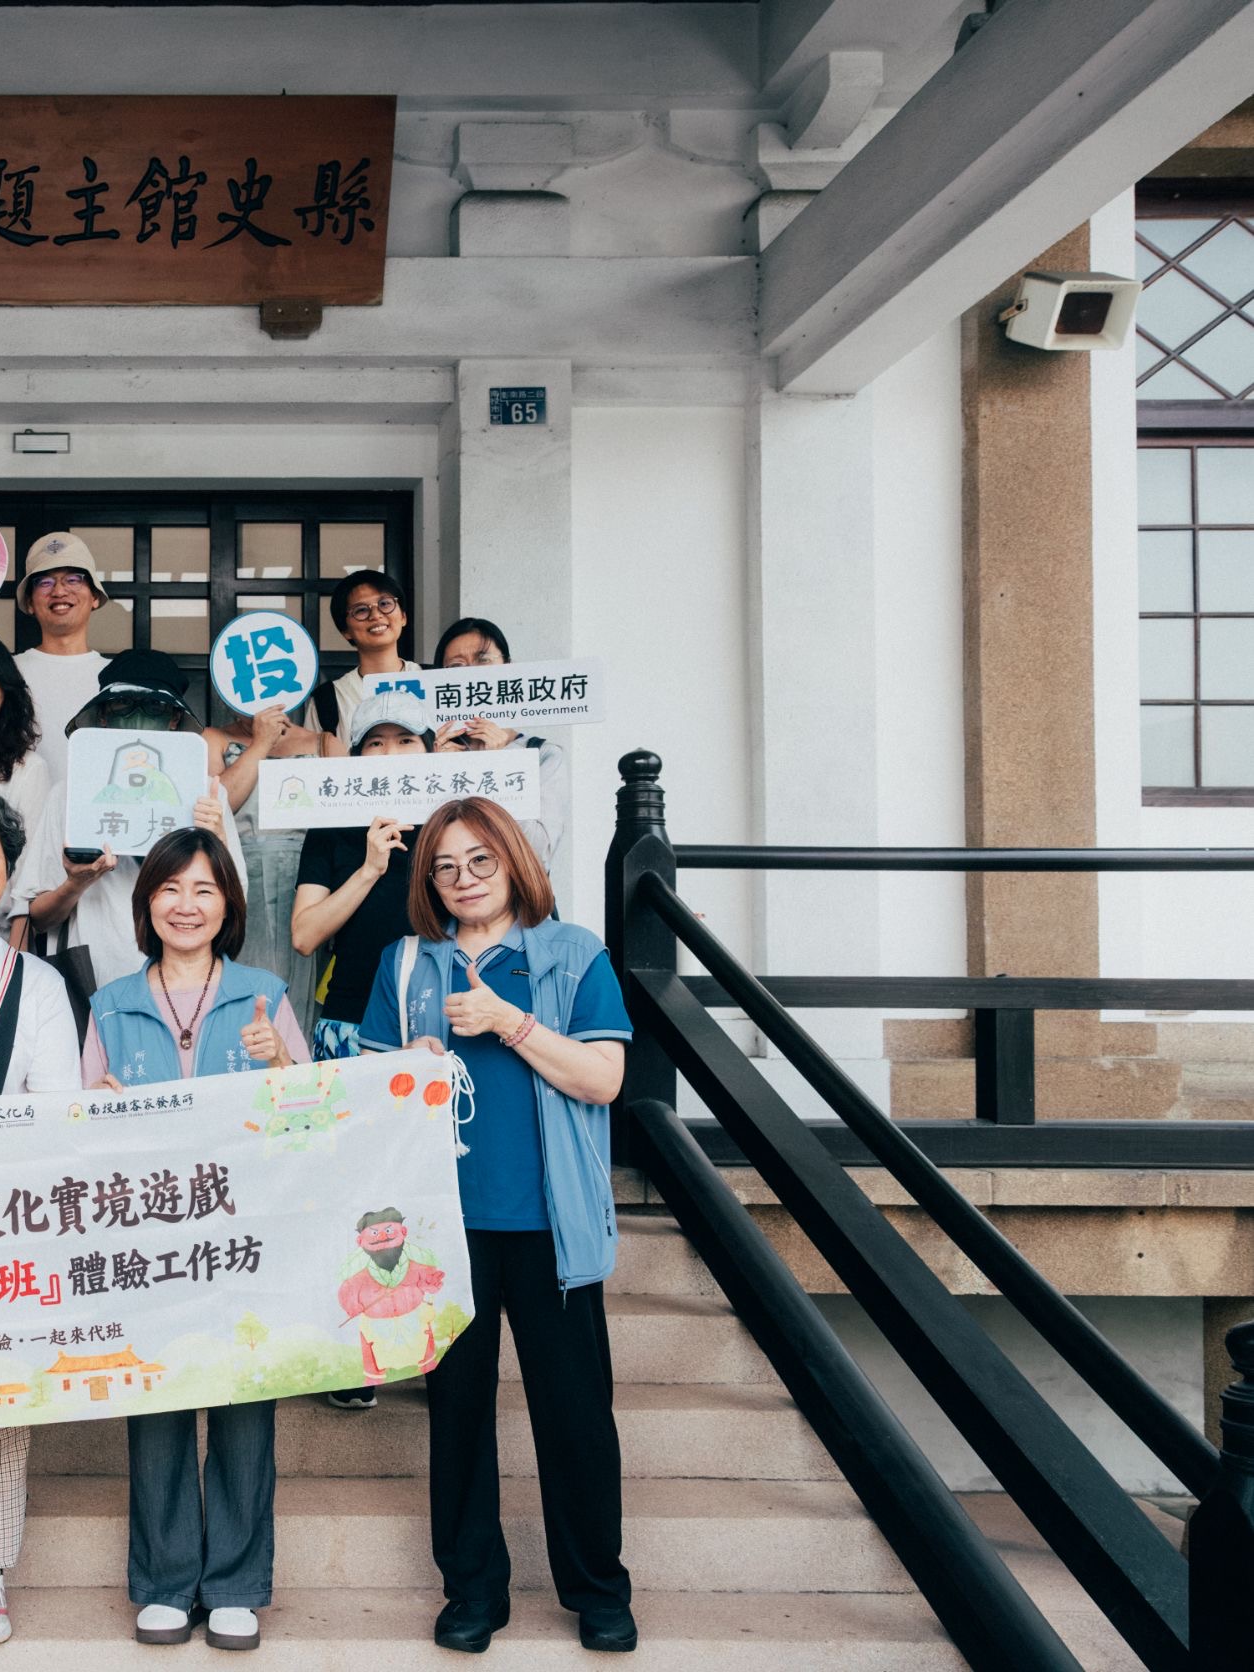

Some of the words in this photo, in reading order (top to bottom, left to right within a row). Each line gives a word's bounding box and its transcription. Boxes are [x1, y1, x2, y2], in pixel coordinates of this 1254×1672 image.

[511, 403, 537, 423] 65
[224, 626, 303, 704] 投
[434, 673, 588, 709] 南投縣政府
[436, 712, 475, 723] Nantou
[479, 708, 517, 721] County
[521, 704, 588, 717] Government
[318, 770, 526, 798] 南投縣客家發展所
[95, 808, 177, 848] 南投
[122, 1064, 134, 1083] 蔡
[88, 1093, 194, 1116] 南投縣客家發展所
